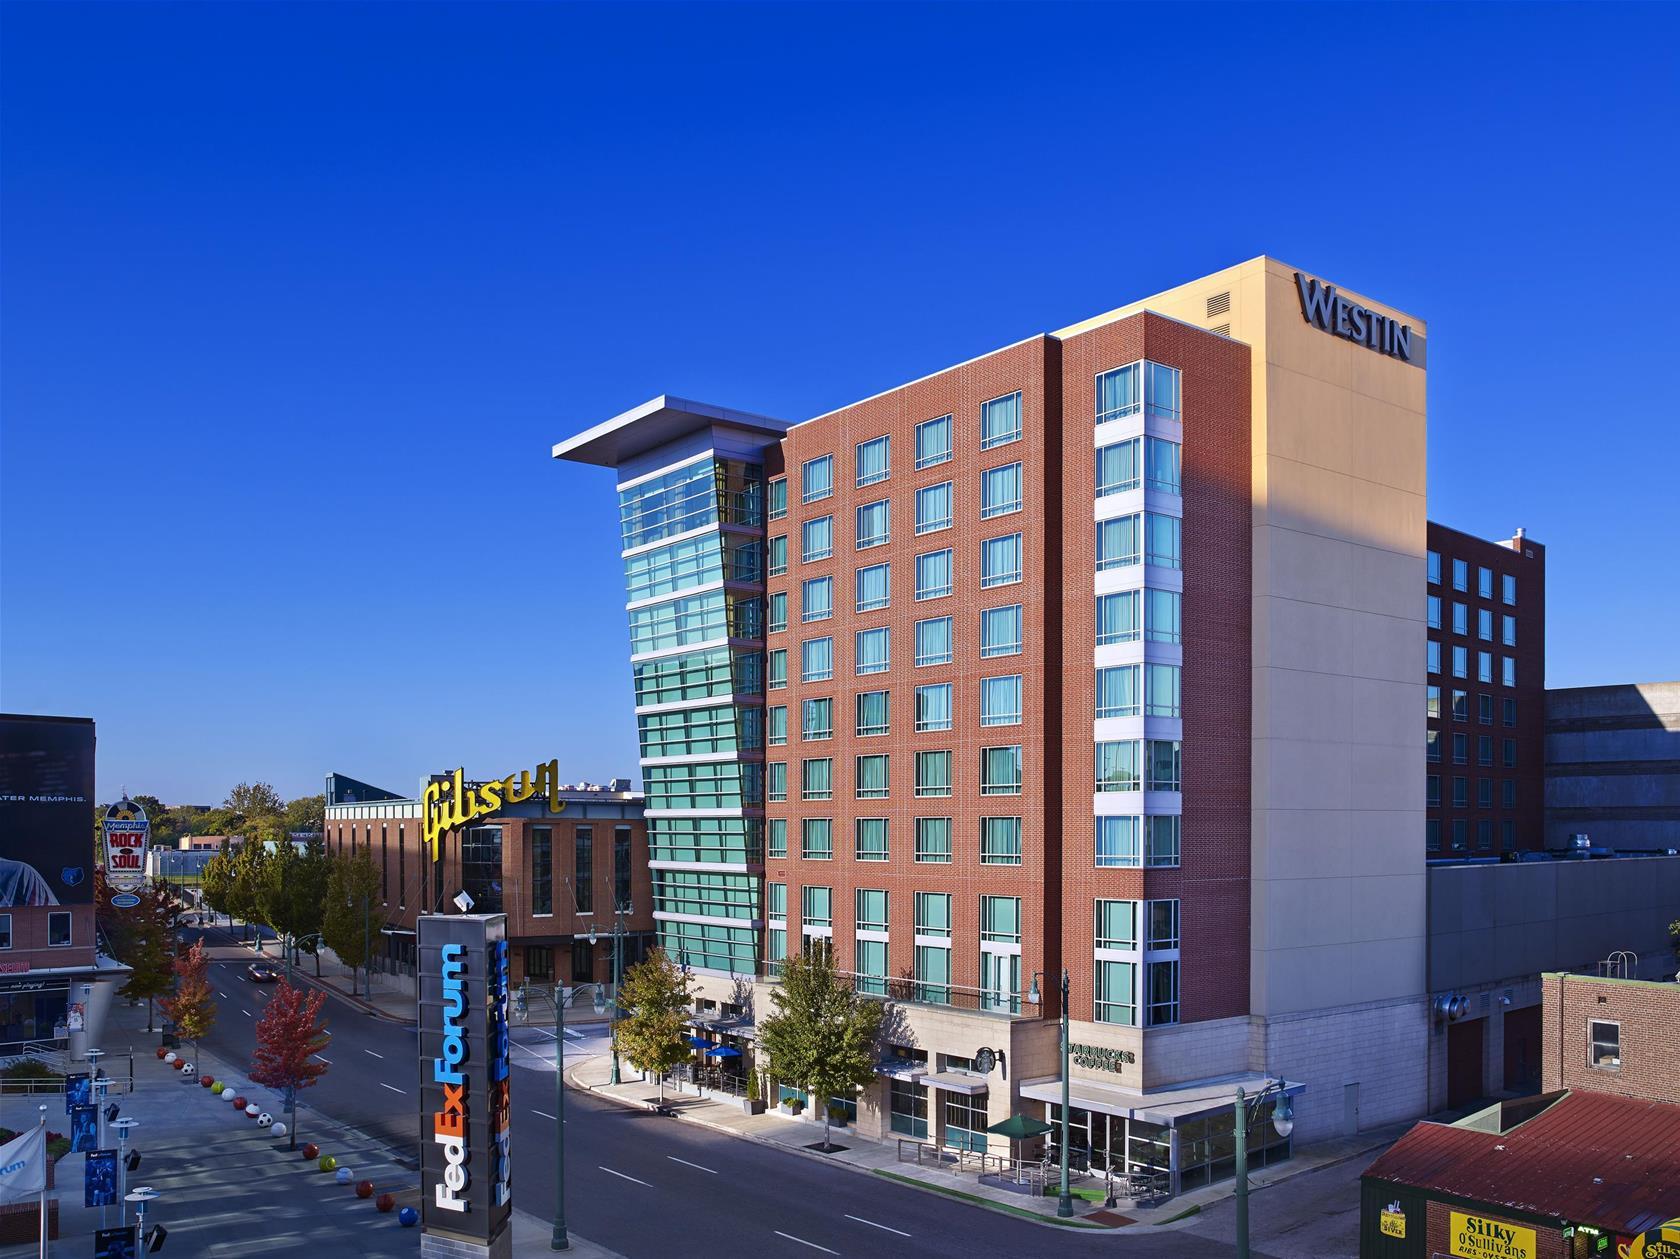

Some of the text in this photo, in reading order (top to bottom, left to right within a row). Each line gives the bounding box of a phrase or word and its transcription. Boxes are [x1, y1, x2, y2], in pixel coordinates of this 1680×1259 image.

[1294, 272, 1411, 361] WESTIN
[423, 759, 566, 862] Gibson
[110, 833, 144, 848] ROCK
[111, 855, 141, 869] SOUL
[1060, 1041, 1134, 1064] TARBUCKS
[1073, 1055, 1121, 1073] COFFEE
[434, 943, 468, 1213] FedExForum
[1466, 1217, 1516, 1246] Silky
[1577, 1225, 1600, 1236] ATM
